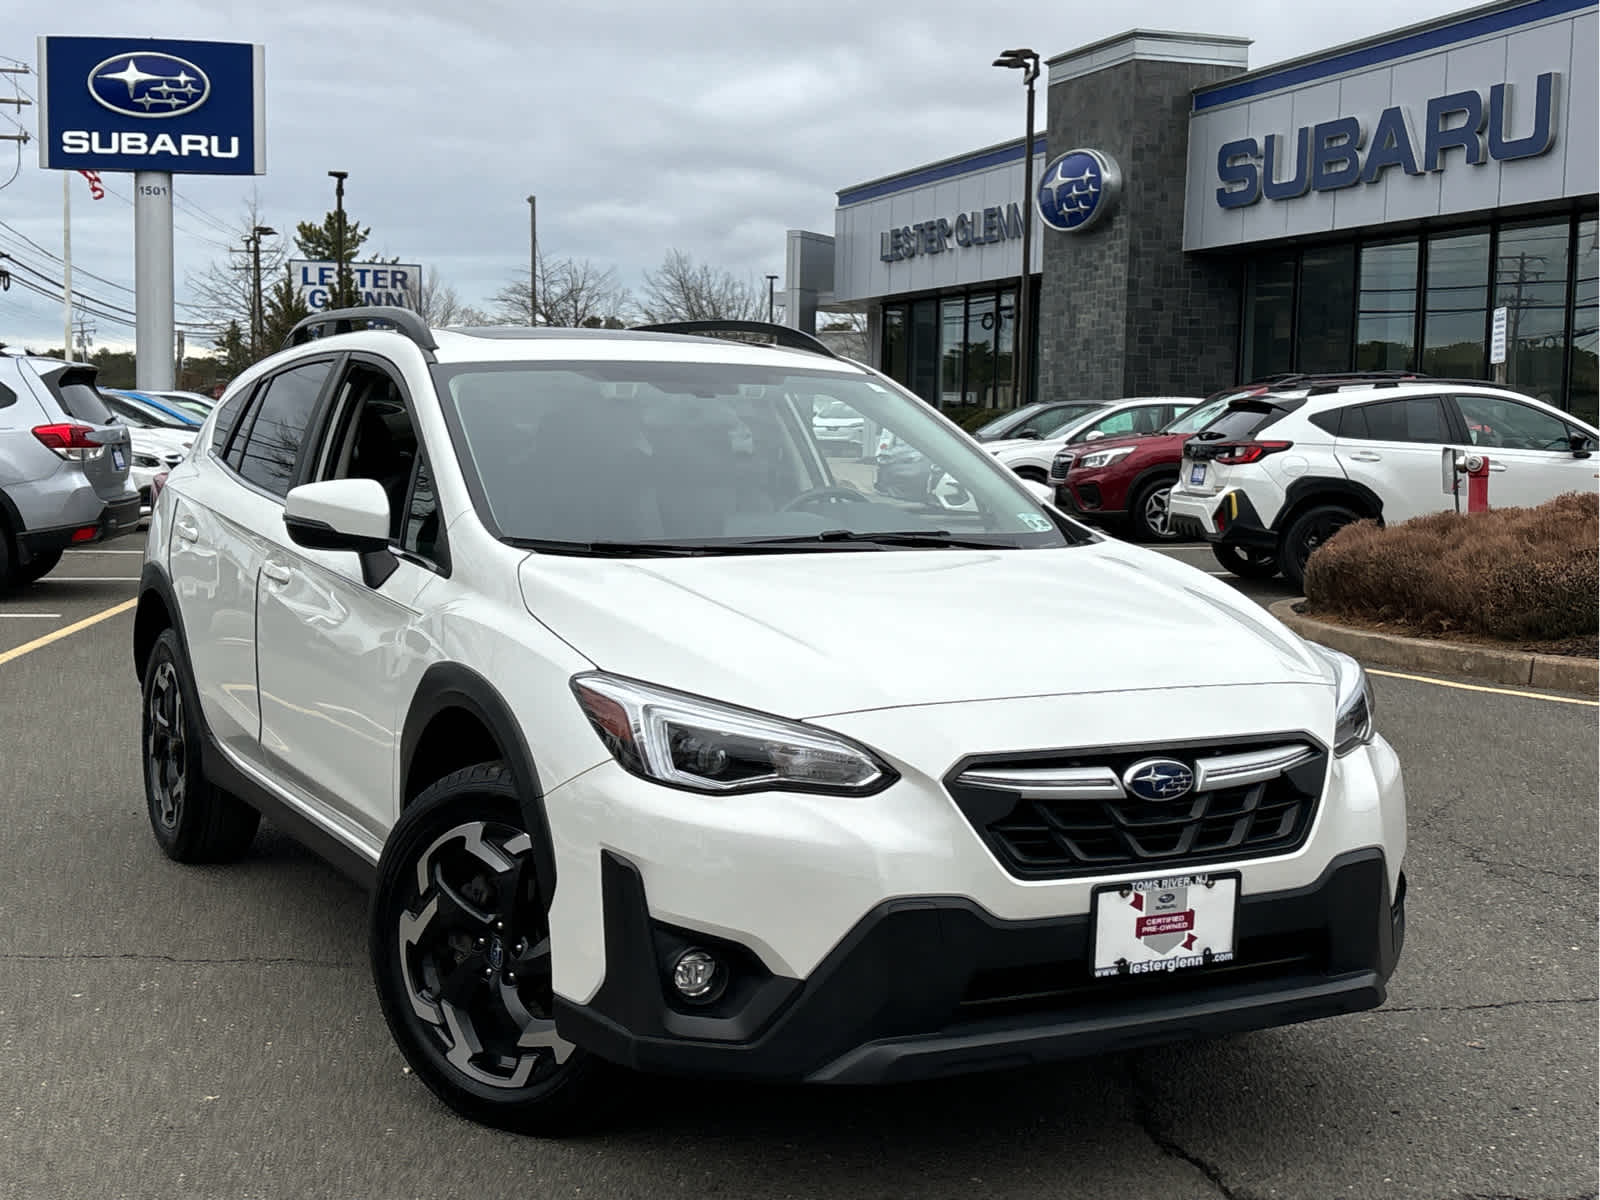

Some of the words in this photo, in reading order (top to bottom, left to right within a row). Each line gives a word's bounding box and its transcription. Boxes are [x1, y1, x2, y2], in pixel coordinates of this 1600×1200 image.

[62, 131, 239, 158] SUBARU
[1216, 71, 1561, 210] SUBARU
[140, 185, 167, 196] 1501
[880, 217, 953, 262] LESTER
[302, 266, 409, 290] LETER
[309, 289, 403, 308] GNN
[1131, 879, 1159, 891] TOMS
[1195, 872, 1208, 885] NJ
[1142, 922, 1189, 933] PRE-OWNED
[1146, 915, 1185, 926] CERTIFIED
[1129, 956, 1203, 975] lesterglenn
